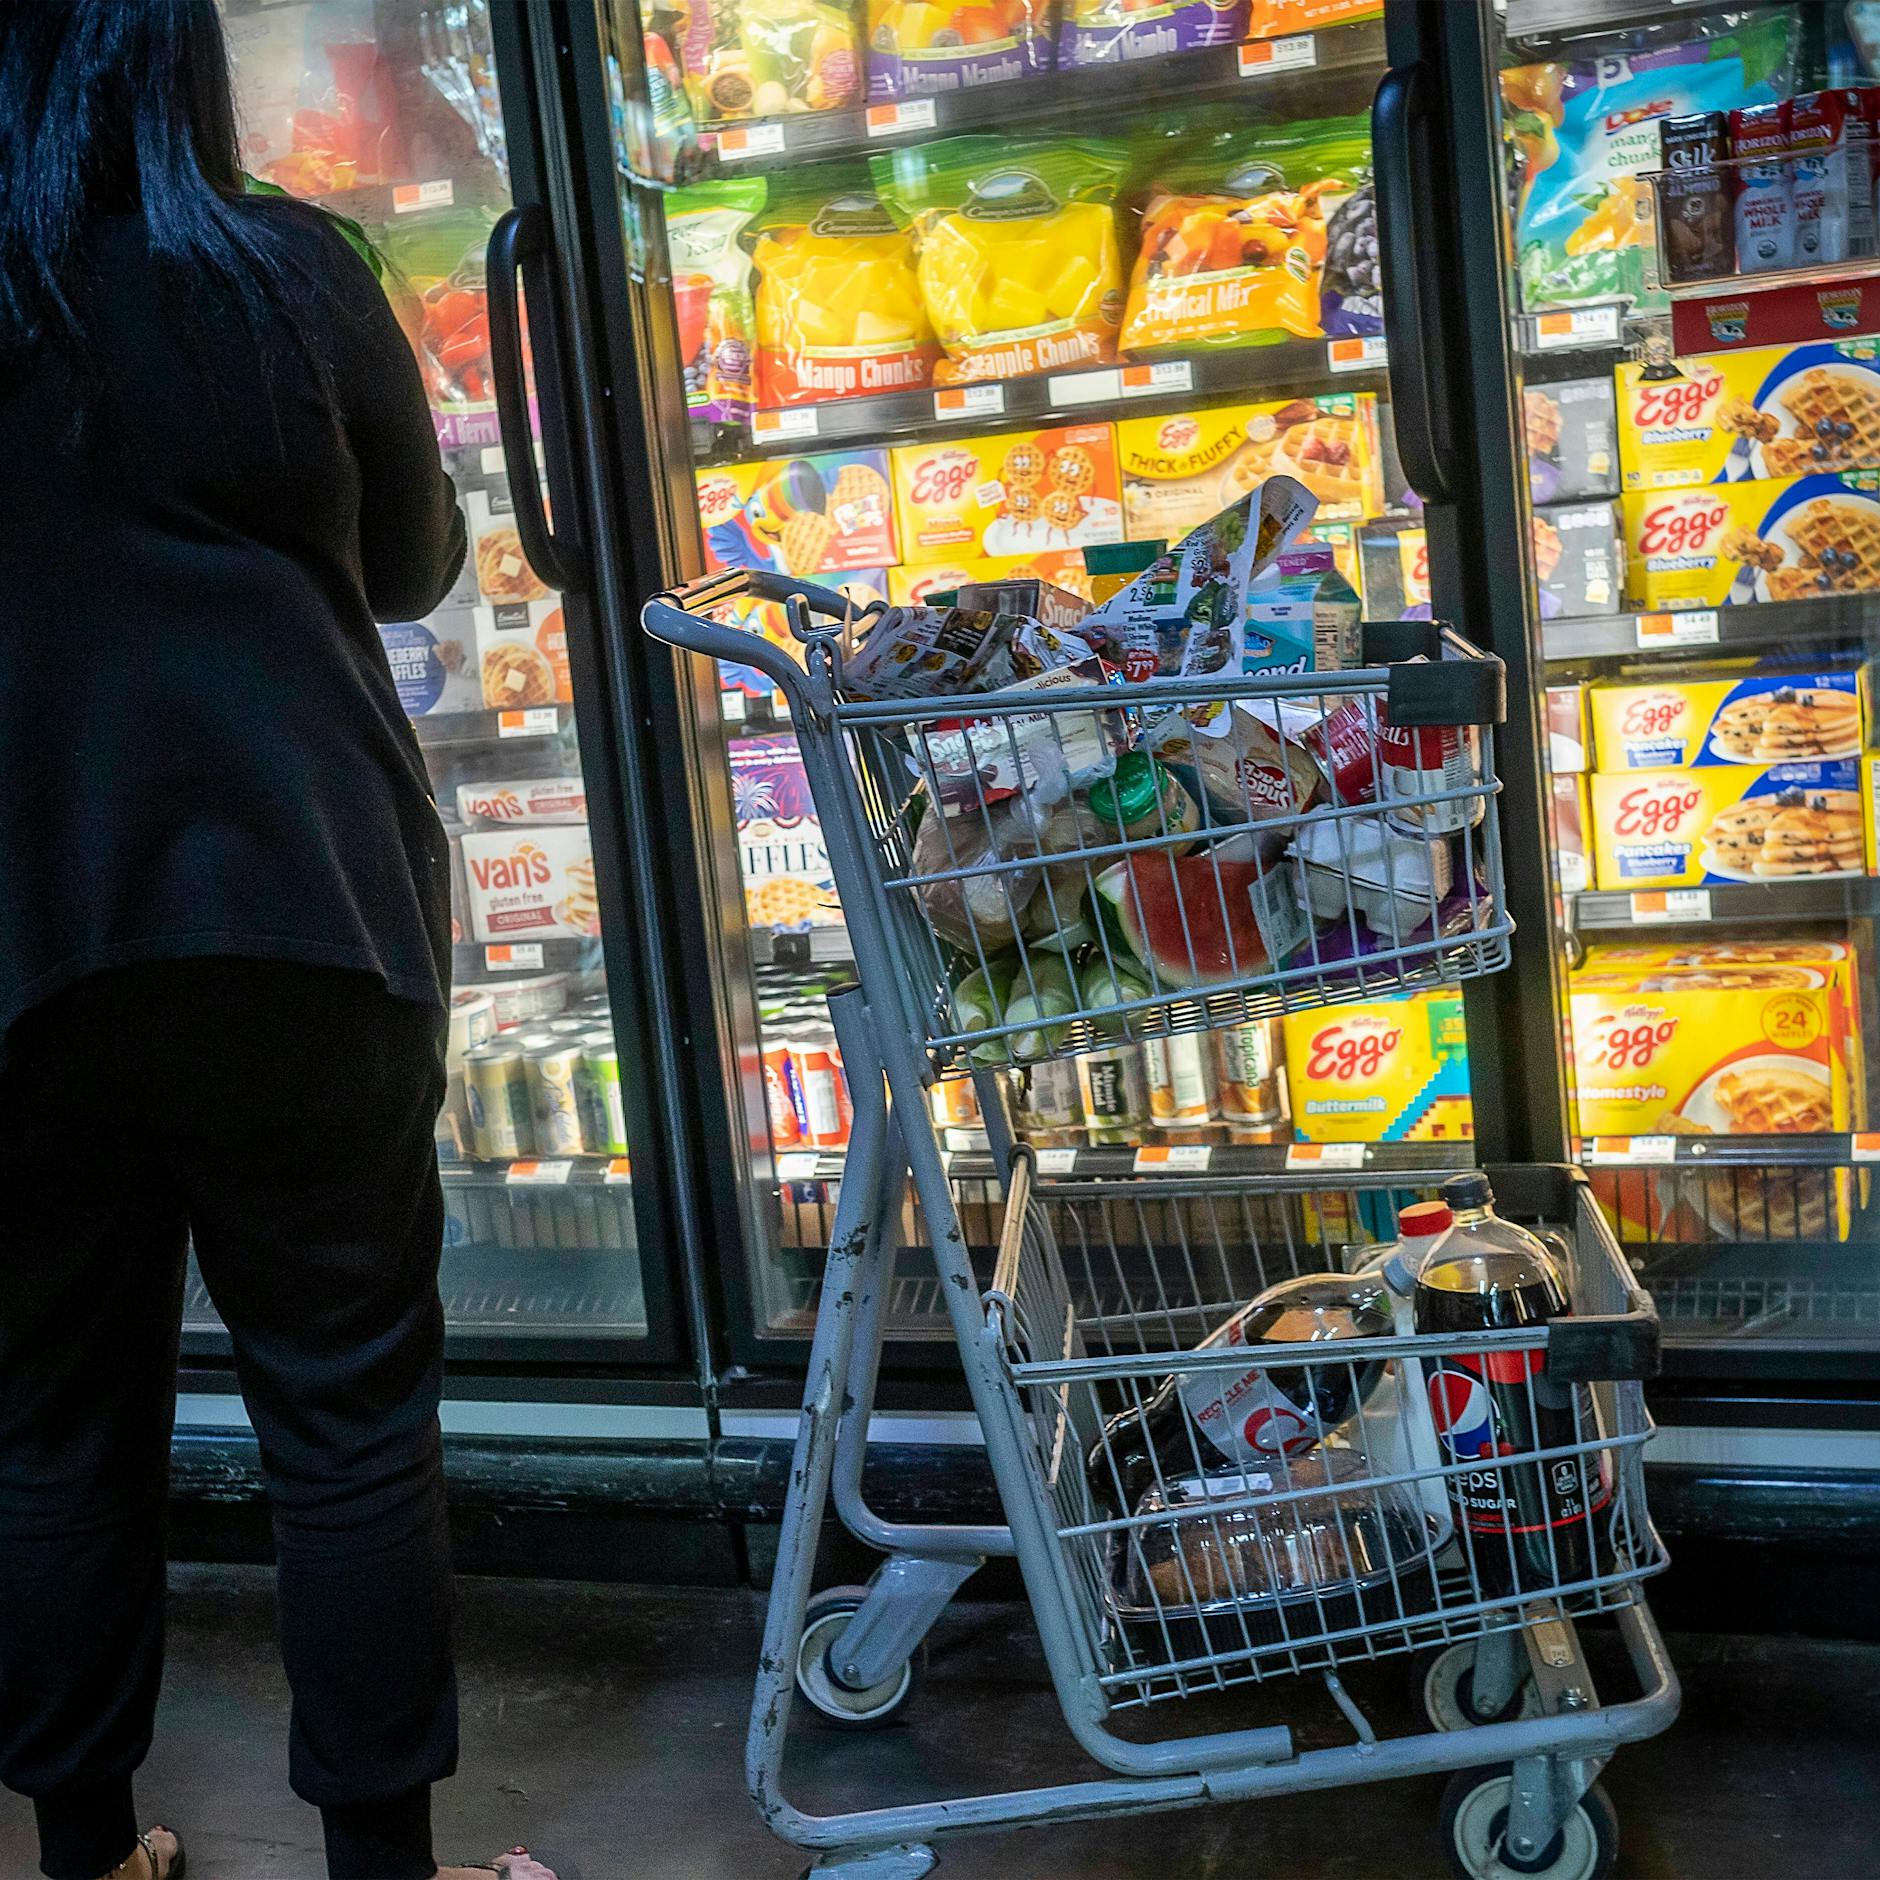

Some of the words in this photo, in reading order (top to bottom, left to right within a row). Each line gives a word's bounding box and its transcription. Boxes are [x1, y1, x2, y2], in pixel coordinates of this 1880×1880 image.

[1668, 142, 1718, 178] Silk
[1743, 204, 1787, 217] WHOLE
[1749, 217, 1783, 229] MILK
[1216, 281, 1251, 312] Mix
[1036, 331, 1100, 369] Chunks
[796, 356, 856, 395] Mango
[860, 354, 925, 388] Chunks
[1633, 375, 1725, 428] Eggo
[1130, 452, 1178, 474] THICK
[1190, 425, 1244, 470] FLUFFY
[1641, 427, 1714, 445] Blueberry
[911, 459, 980, 504] Eggo
[1638, 504, 1730, 555] Eggo
[1646, 556, 1718, 573] Blueberry
[1130, 587, 1138, 603] 2
[1621, 698, 1688, 735] Eggo
[1613, 788, 1702, 837] Eggo
[1612, 841, 1692, 859] Pancakes
[489, 895, 522, 911] gluten
[522, 892, 544, 905] free
[497, 911, 543, 926] ORIGINAL
[1775, 1011, 1808, 1030] 24
[1240, 1023, 1260, 1088] Tropicana
[1306, 1026, 1403, 1081] Eggo
[1580, 1014, 1679, 1070] Eggo
[1305, 1095, 1388, 1115] Buttermilk
[1575, 1084, 1667, 1102] Homestyle
[1469, 1496, 1518, 1510] SUGAR
